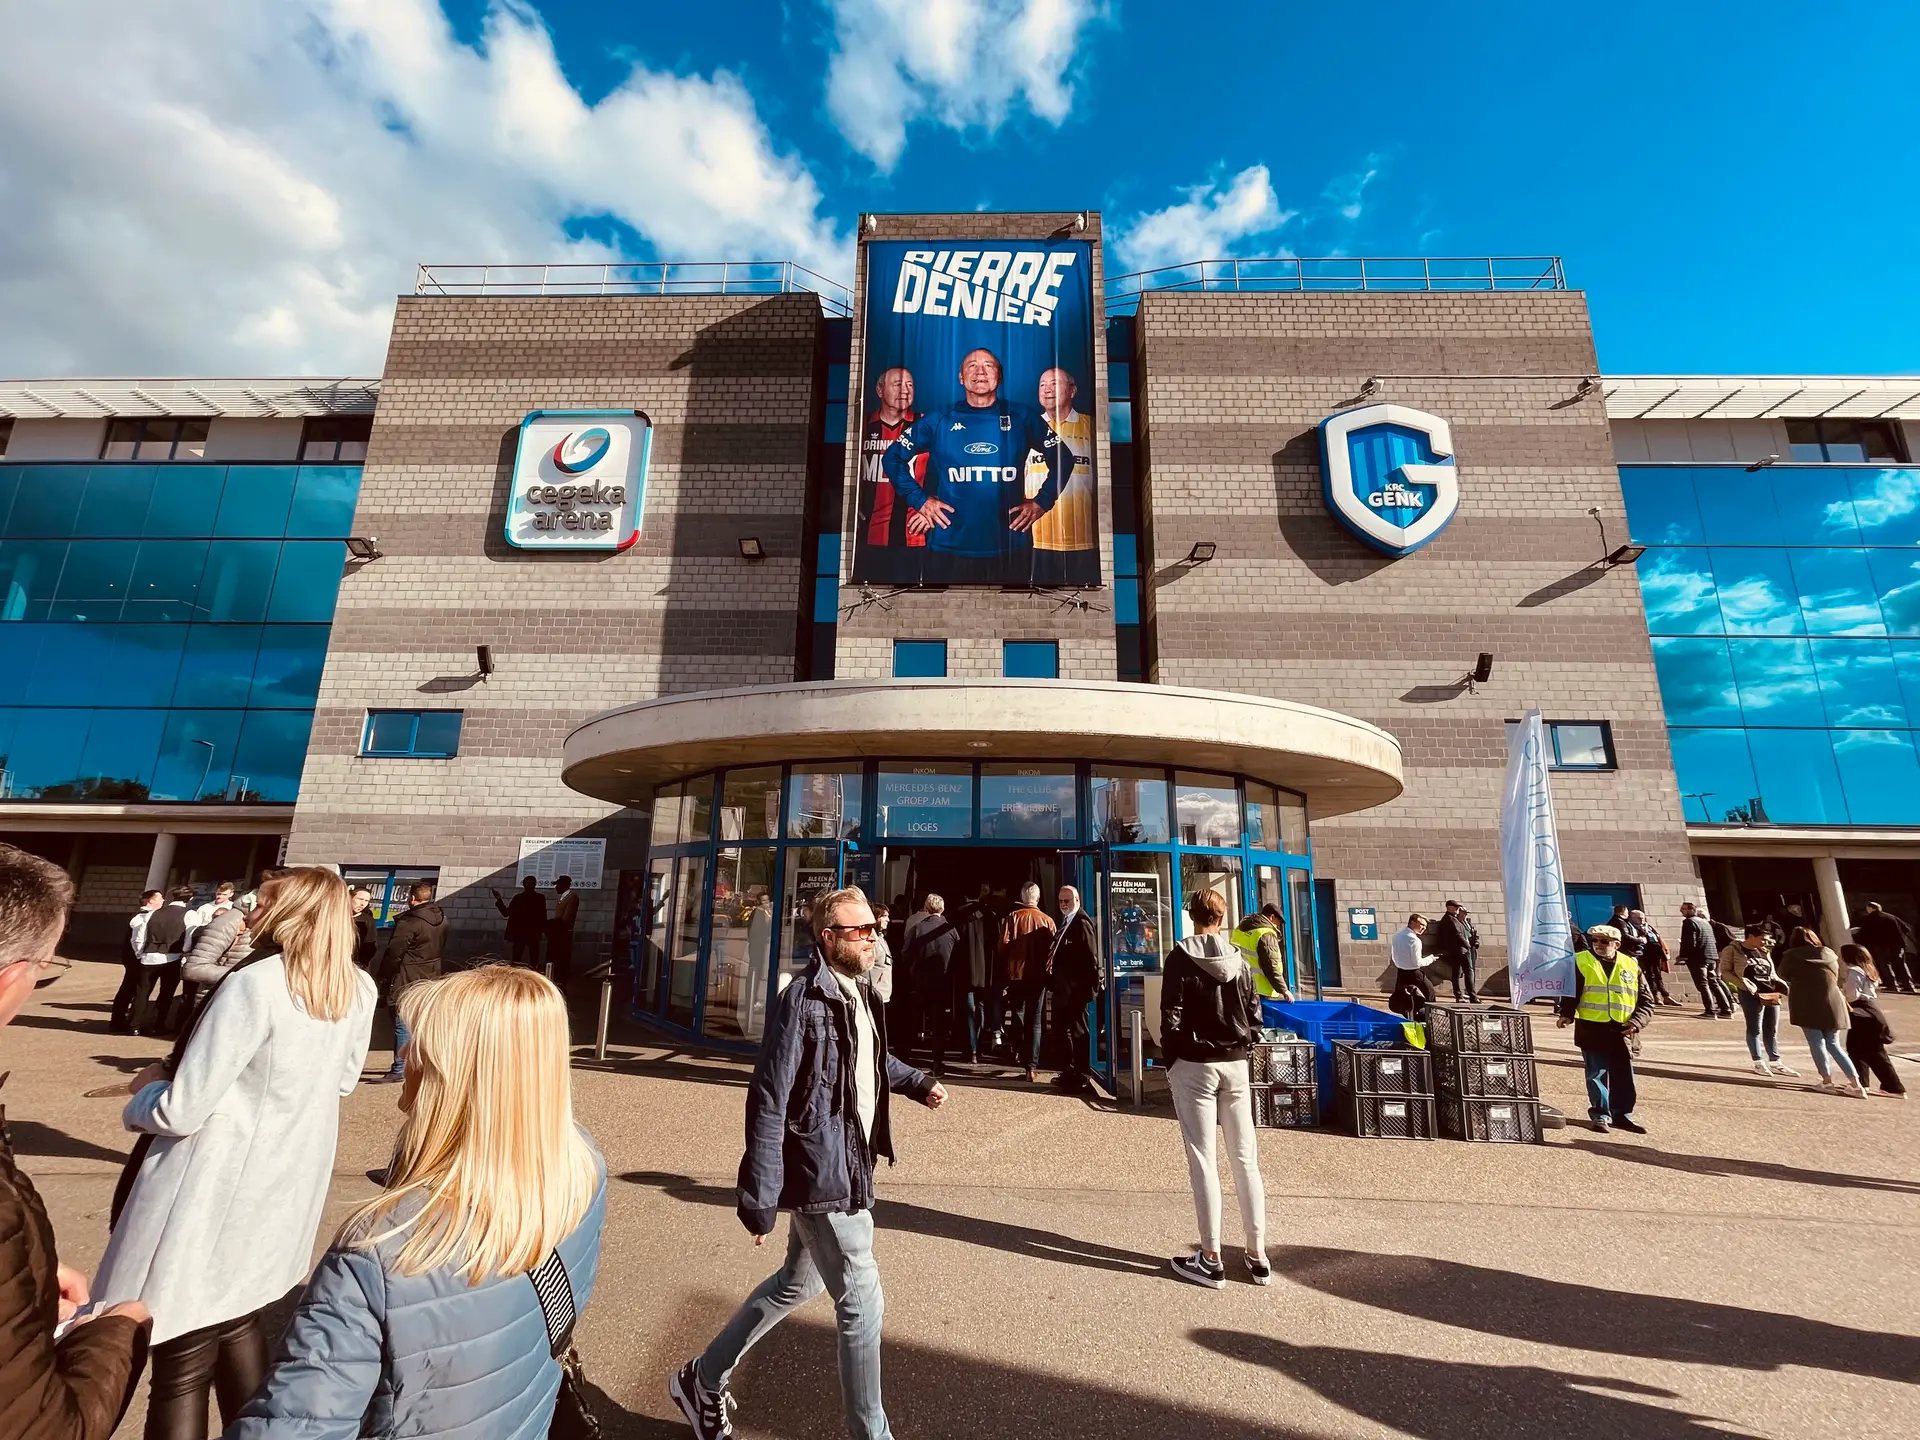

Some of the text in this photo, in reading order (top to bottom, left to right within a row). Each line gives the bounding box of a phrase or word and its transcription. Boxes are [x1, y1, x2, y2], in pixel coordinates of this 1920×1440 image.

[904, 251, 1077, 311] PIERRE
[892, 261, 1052, 327] DENIER
[896, 434, 914, 451] sec
[970, 444, 991, 453] Ford
[948, 466, 1017, 482] NITTO
[1385, 483, 1405, 492] KRC
[526, 479, 627, 511] cegeka
[1368, 491, 1424, 508] GENK
[532, 511, 614, 530] arena
[913, 767, 936, 775] INKOM
[885, 783, 963, 793] MERCEDES-BENZ
[1008, 785, 1052, 794] THE CLUB
[896, 796, 950, 806] GROEP JAM
[907, 822, 939, 832] LOGES
